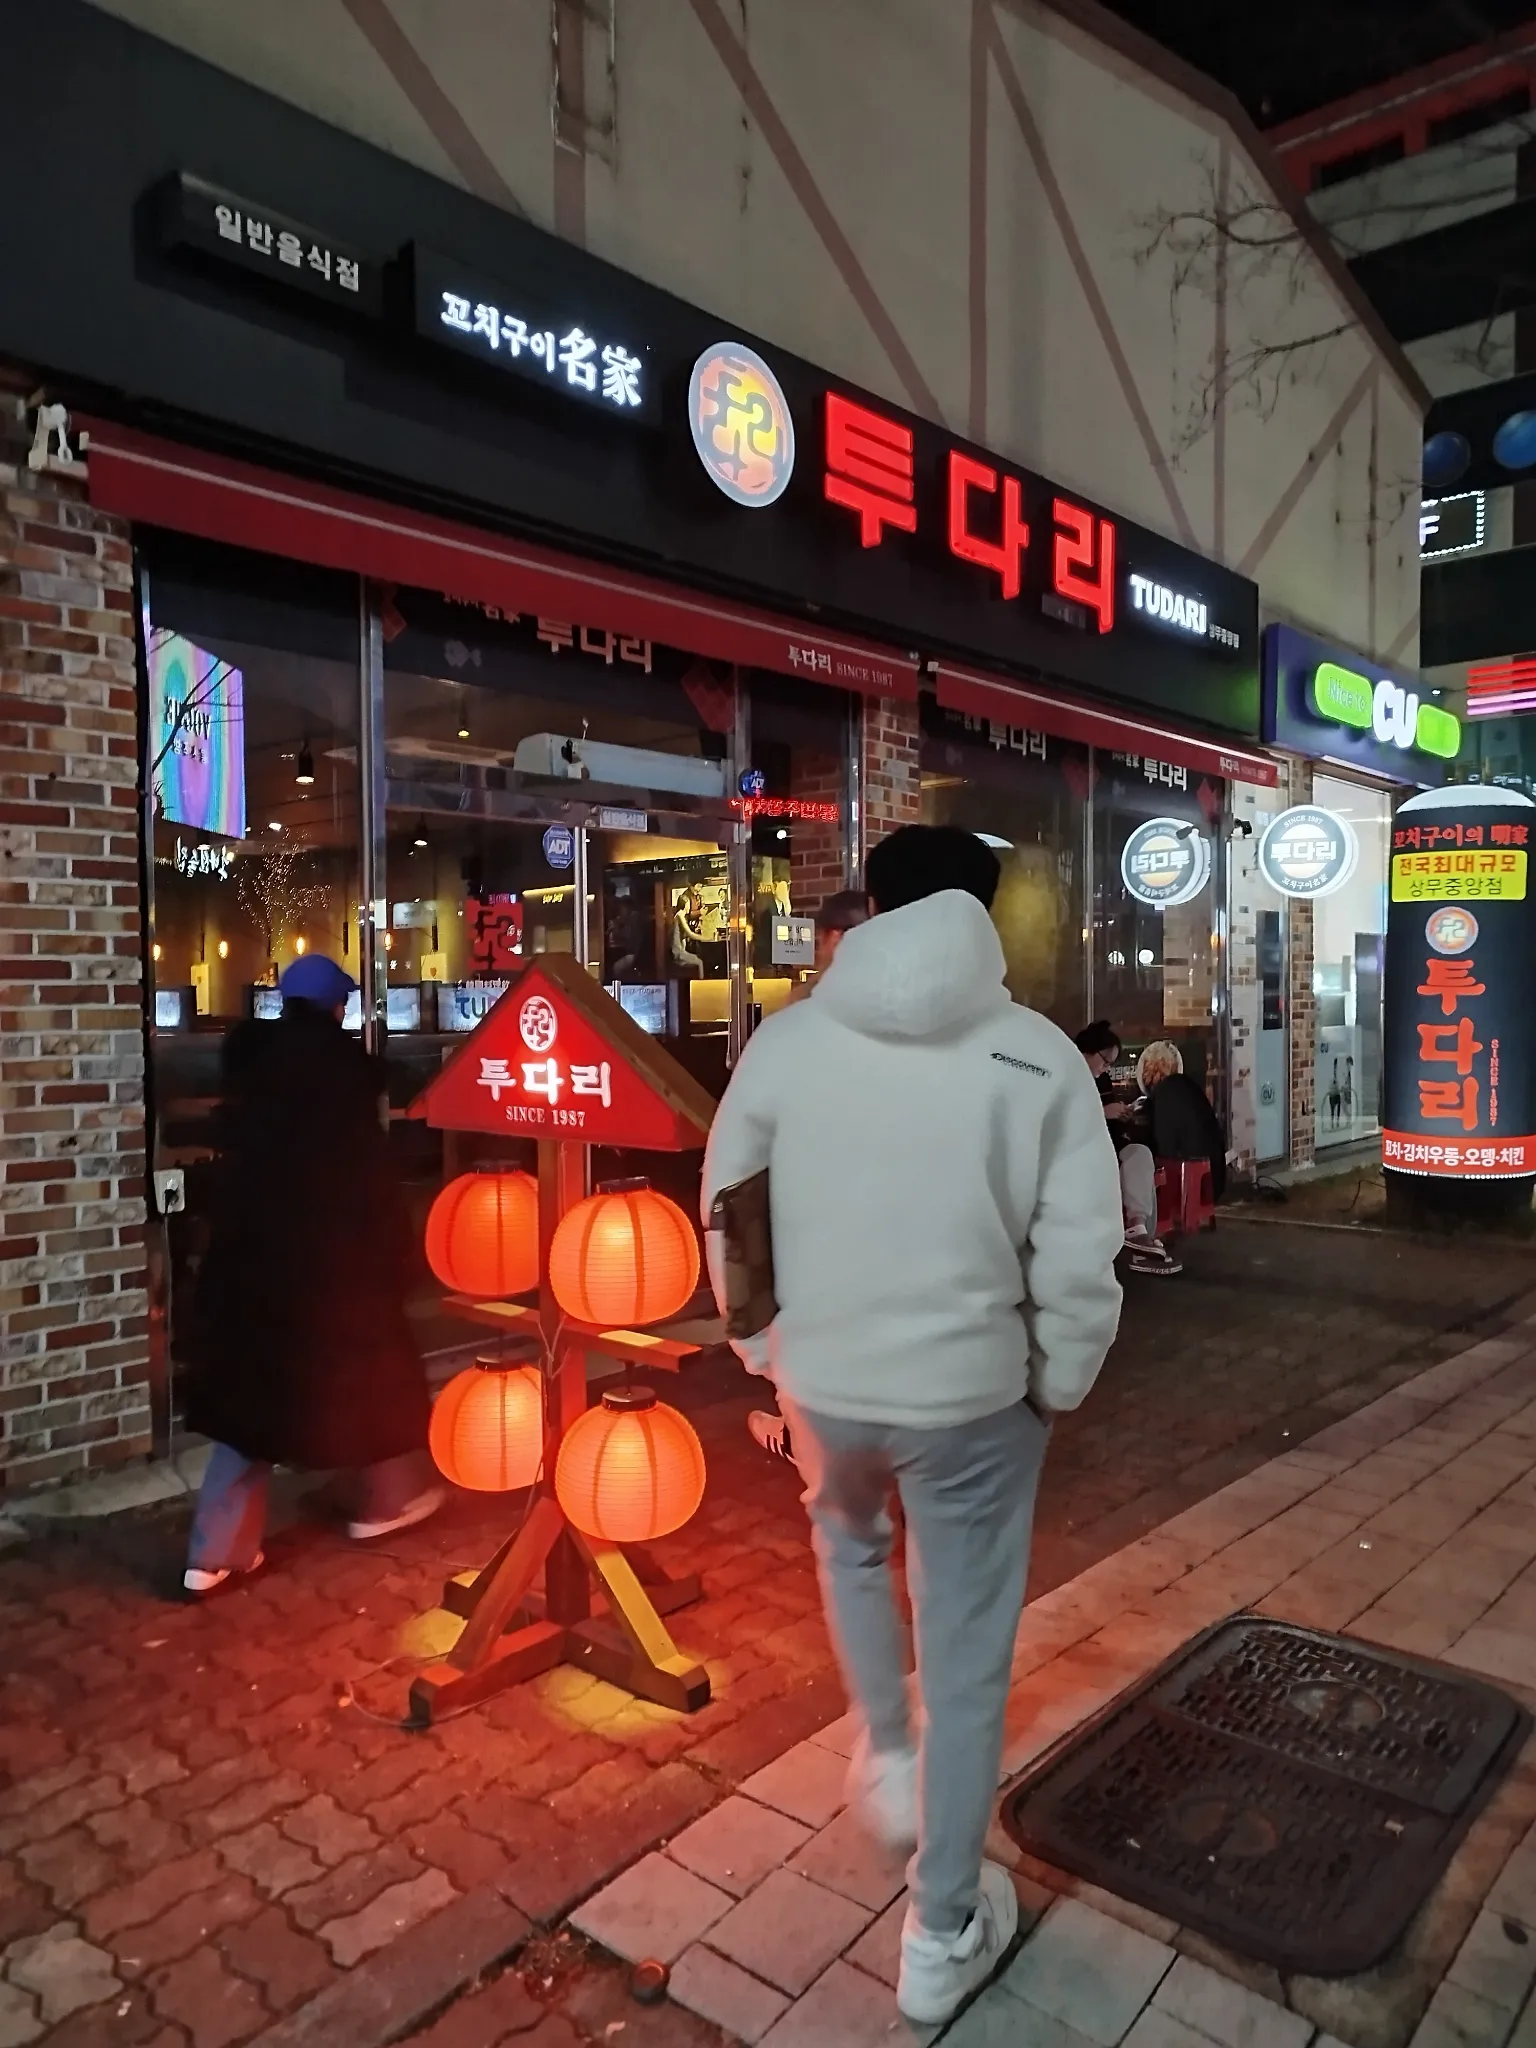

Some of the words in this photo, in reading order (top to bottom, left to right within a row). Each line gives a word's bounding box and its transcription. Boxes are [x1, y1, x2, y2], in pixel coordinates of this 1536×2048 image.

[215, 205, 359, 292] 일반음식점
[441, 291, 643, 406] 꼬치구이名家
[824, 390, 1116, 635] 투다리
[1130, 573, 1207, 634] TUDARI
[788, 644, 832, 675] 투다리
[837, 662, 869, 681] SINCE
[1372, 679, 1419, 748] CU
[1144, 756, 1188, 793] 투다리
[1283, 815, 1306, 828] SINCE
[1394, 823, 1484, 849] 꼬치구이의
[548, 838, 570, 857] ADT
[1270, 840, 1337, 863] 투다리
[1409, 877, 1503, 898] 상무중앙점
[1416, 958, 1487, 1131] 투다리
[476, 1057, 612, 1109] 투다리
[506, 1105, 546, 1123] SINCE
[552, 1109, 586, 1128] 1987
